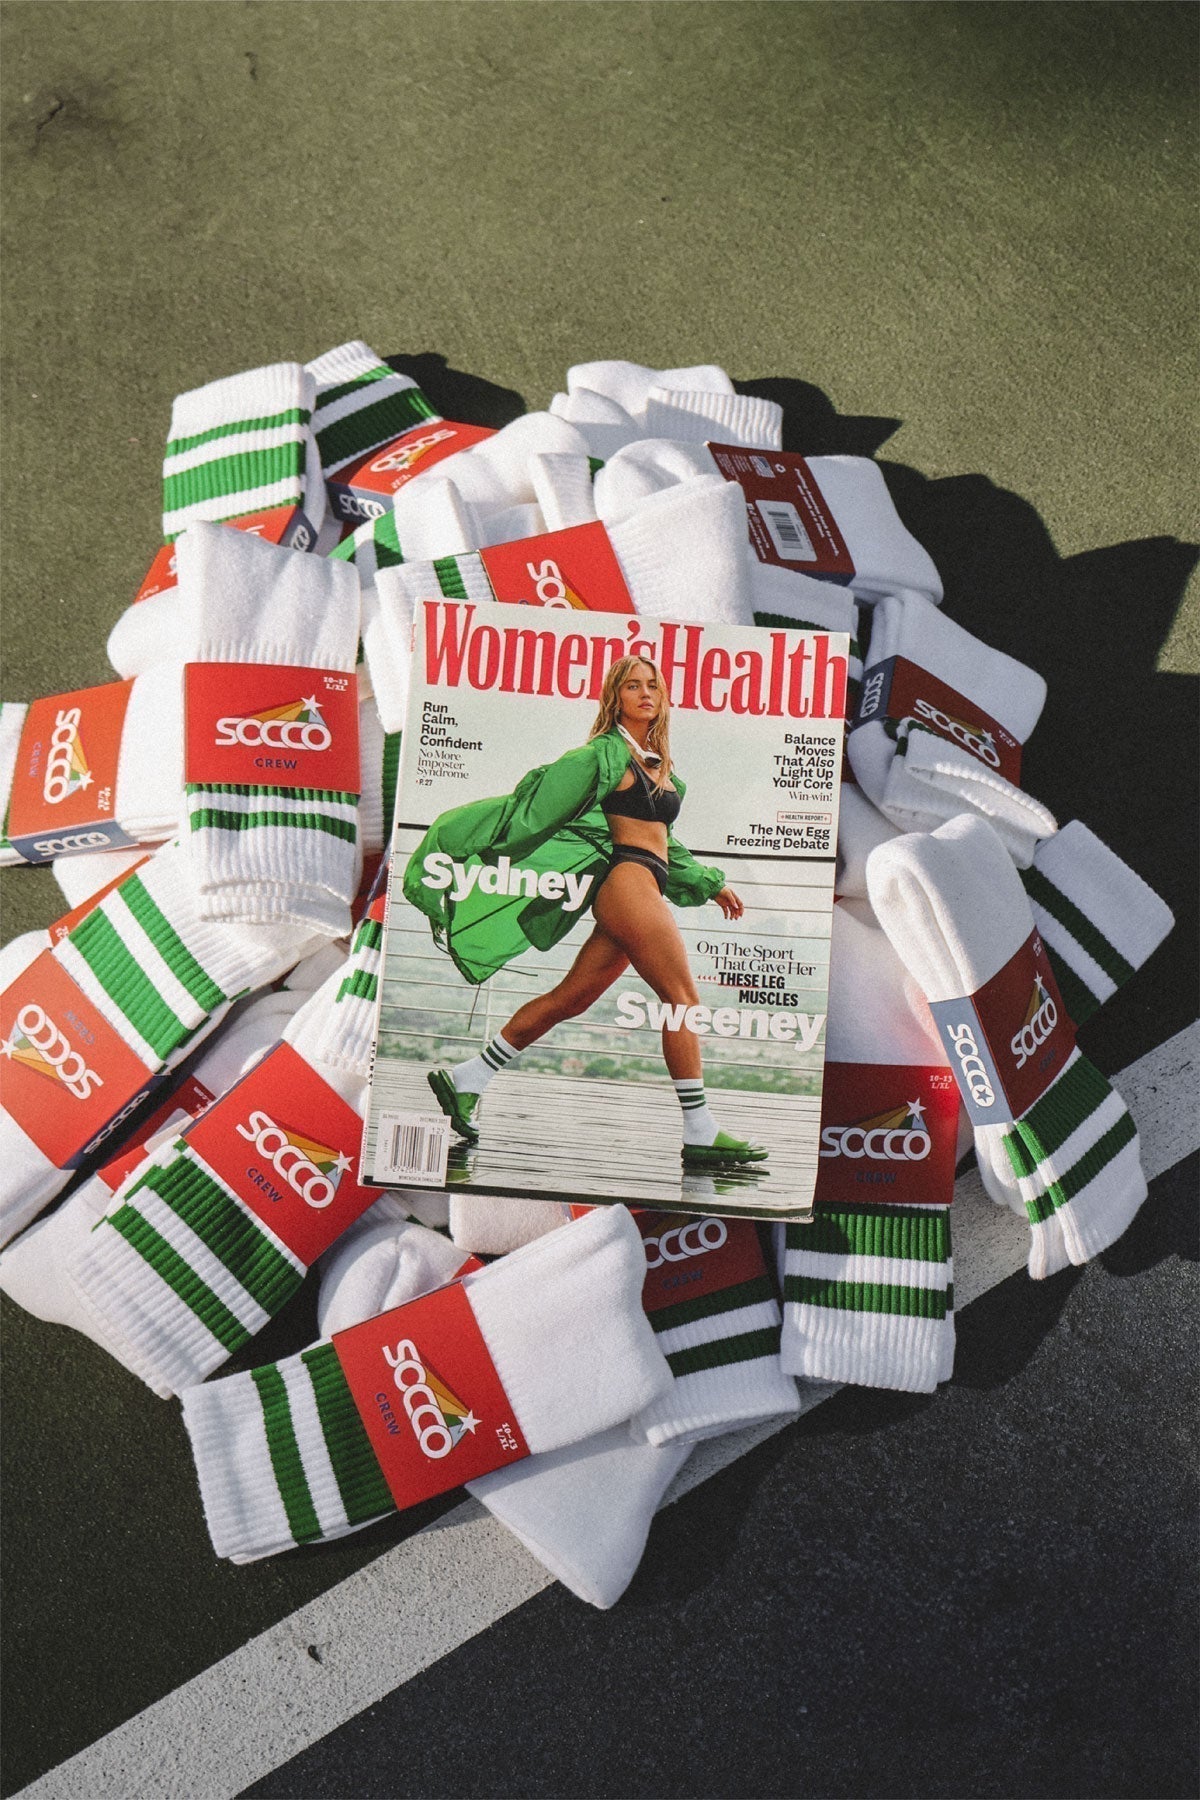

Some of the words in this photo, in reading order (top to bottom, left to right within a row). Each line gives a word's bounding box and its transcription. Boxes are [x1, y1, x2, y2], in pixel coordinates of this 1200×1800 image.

[370, 429, 458, 472] SOCCO
[660, 623, 847, 718] Health
[423, 702, 448, 713] Run
[422, 713, 458, 727] Calm,
[215, 717, 332, 752] SOCCO
[421, 725, 446, 736] Run
[785, 734, 836, 746] Balance
[913, 698, 1001, 768] SOCCO
[420, 736, 483, 751] Confident
[795, 745, 835, 757] Moves
[29, 742, 42, 778] CREW
[43, 707, 82, 804] SOCCO
[254, 758, 298, 770] CREW
[418, 758, 465, 770] Imposter
[419, 749, 434, 759] No
[437, 750, 461, 760] More
[774, 755, 804, 767] That
[806, 757, 835, 768] Also
[417, 768, 470, 780] Syndrome
[773, 777, 801, 788] Your
[804, 779, 833, 790] Core
[781, 767, 814, 780] Light
[817, 769, 834, 781] Up
[789, 791, 833, 802] Win-win!
[726, 835, 781, 850] Freezing
[783, 838, 830, 850] Debate
[749, 824, 773, 836] The
[776, 825, 804, 837] New
[806, 827, 831, 841] Egg
[33, 832, 112, 857] SOCCO
[421, 852, 595, 912] Sydney
[697, 940, 719, 955] On
[721, 942, 751, 957] The
[753, 944, 794, 961] Sport
[711, 956, 746, 972] That
[749, 959, 786, 974] Gave
[787, 961, 817, 976] Her
[718, 972, 760, 987] THESE
[761, 975, 786, 989] LEG
[738, 989, 799, 1007] MUSCLES
[64, 1010, 96, 1045] CREW
[614, 991, 827, 1052] Sweeney
[1010, 997, 1058, 1070] SOCCO
[17, 1004, 104, 1100] SOCCO
[946, 1023, 996, 1107] SOCCO
[819, 1126, 932, 1161] SOCCO
[235, 1110, 335, 1208] SOCCO
[247, 1167, 283, 1203] CREW
[855, 1172, 897, 1184] CREW
[643, 1218, 728, 1269] OCCO
[382, 1338, 453, 1459] SOCCO
[375, 1392, 400, 1436] CREW
